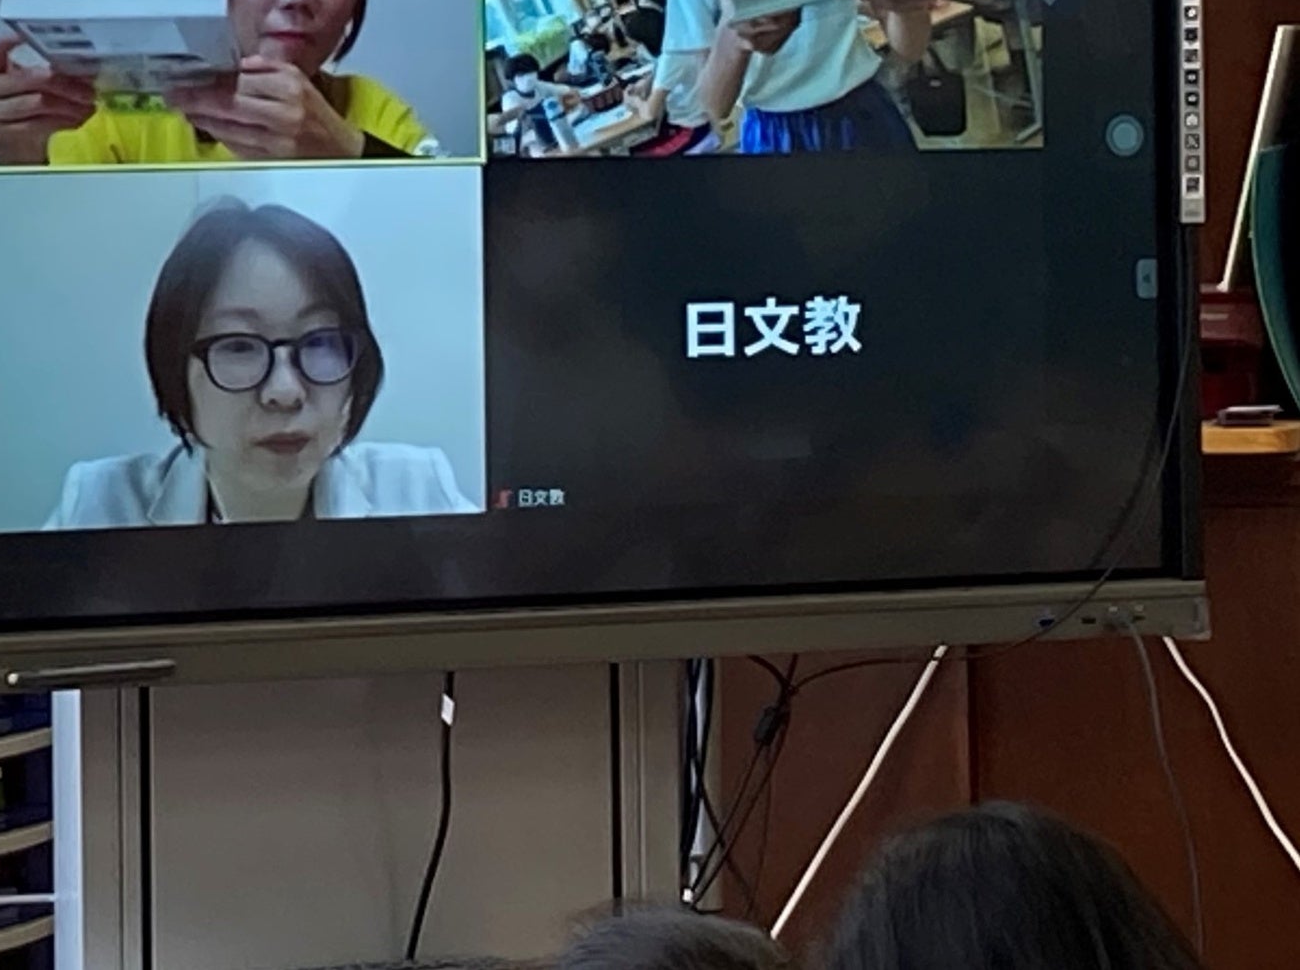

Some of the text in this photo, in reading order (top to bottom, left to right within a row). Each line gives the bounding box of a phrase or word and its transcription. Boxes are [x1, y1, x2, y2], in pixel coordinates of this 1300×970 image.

[686, 295, 862, 358] 日文教
[518, 489, 565, 506] 日文教
